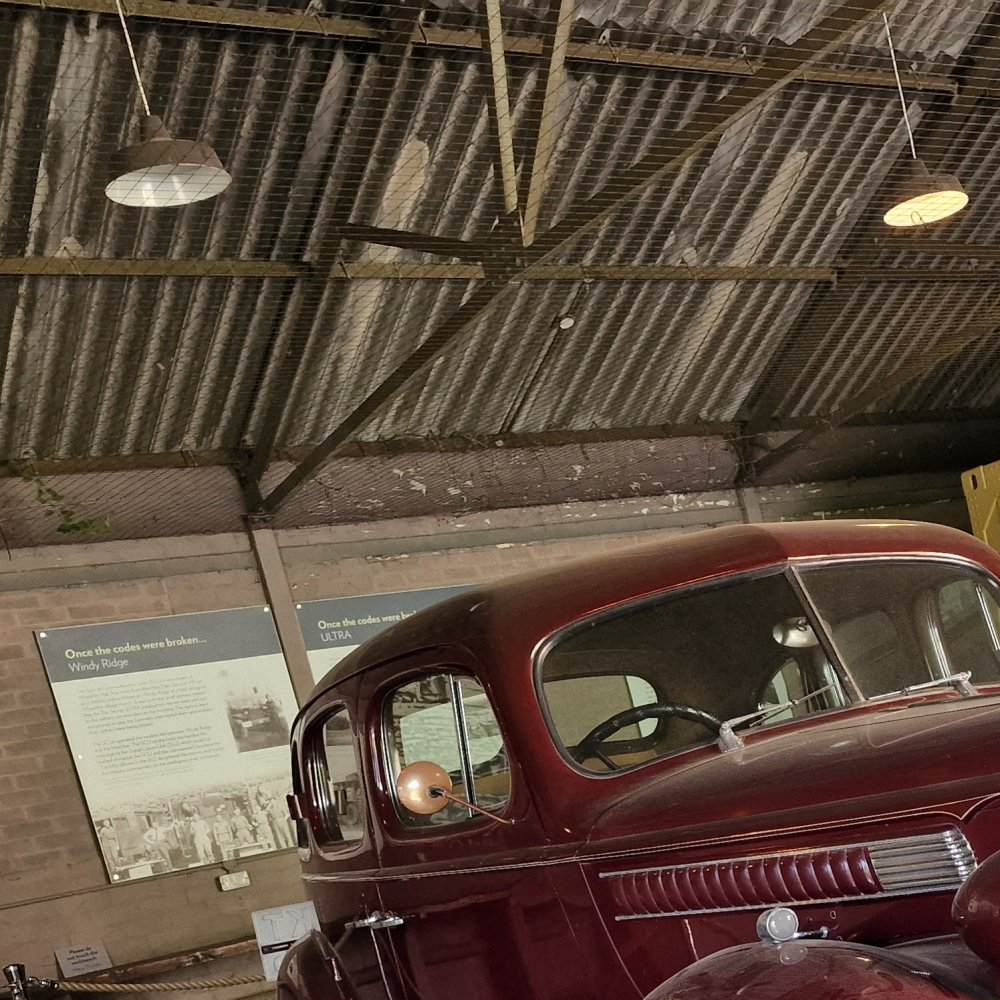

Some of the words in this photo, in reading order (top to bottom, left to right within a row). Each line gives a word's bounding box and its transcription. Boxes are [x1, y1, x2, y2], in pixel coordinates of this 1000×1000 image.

[318, 620, 341, 630] Once
[342, 618, 356, 627] the
[357, 615, 381, 624] codes
[381, 614, 400, 622] were
[320, 630, 352, 642] ULTRA
[65, 648, 93, 660] Once
[94, 646, 111, 656] the
[112, 642, 141, 653] codes
[142, 641, 165, 650] were
[68, 659, 100, 673] Windy
[102, 657, 129, 669] Ridge
